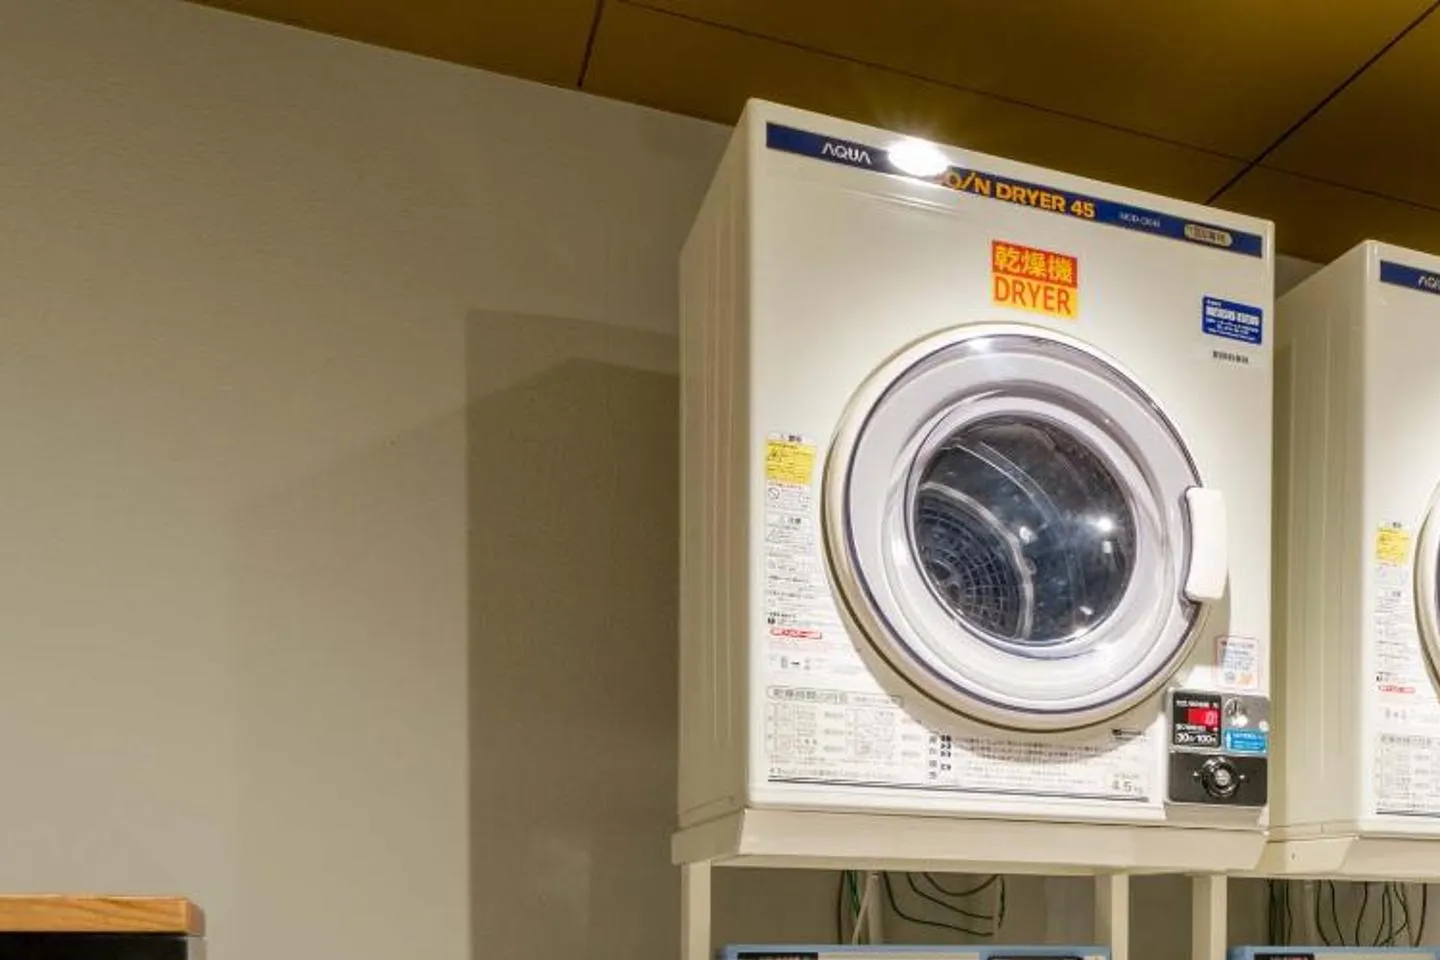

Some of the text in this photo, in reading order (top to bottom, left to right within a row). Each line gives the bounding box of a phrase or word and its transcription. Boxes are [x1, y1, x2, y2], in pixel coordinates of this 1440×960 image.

[821, 143, 871, 165] AQUA
[938, 168, 990, 195] OIN
[996, 182, 1065, 213] DRYER
[1070, 200, 1096, 219] 45
[993, 243, 1074, 284] 乾燥機
[994, 275, 1072, 315] DRYER
